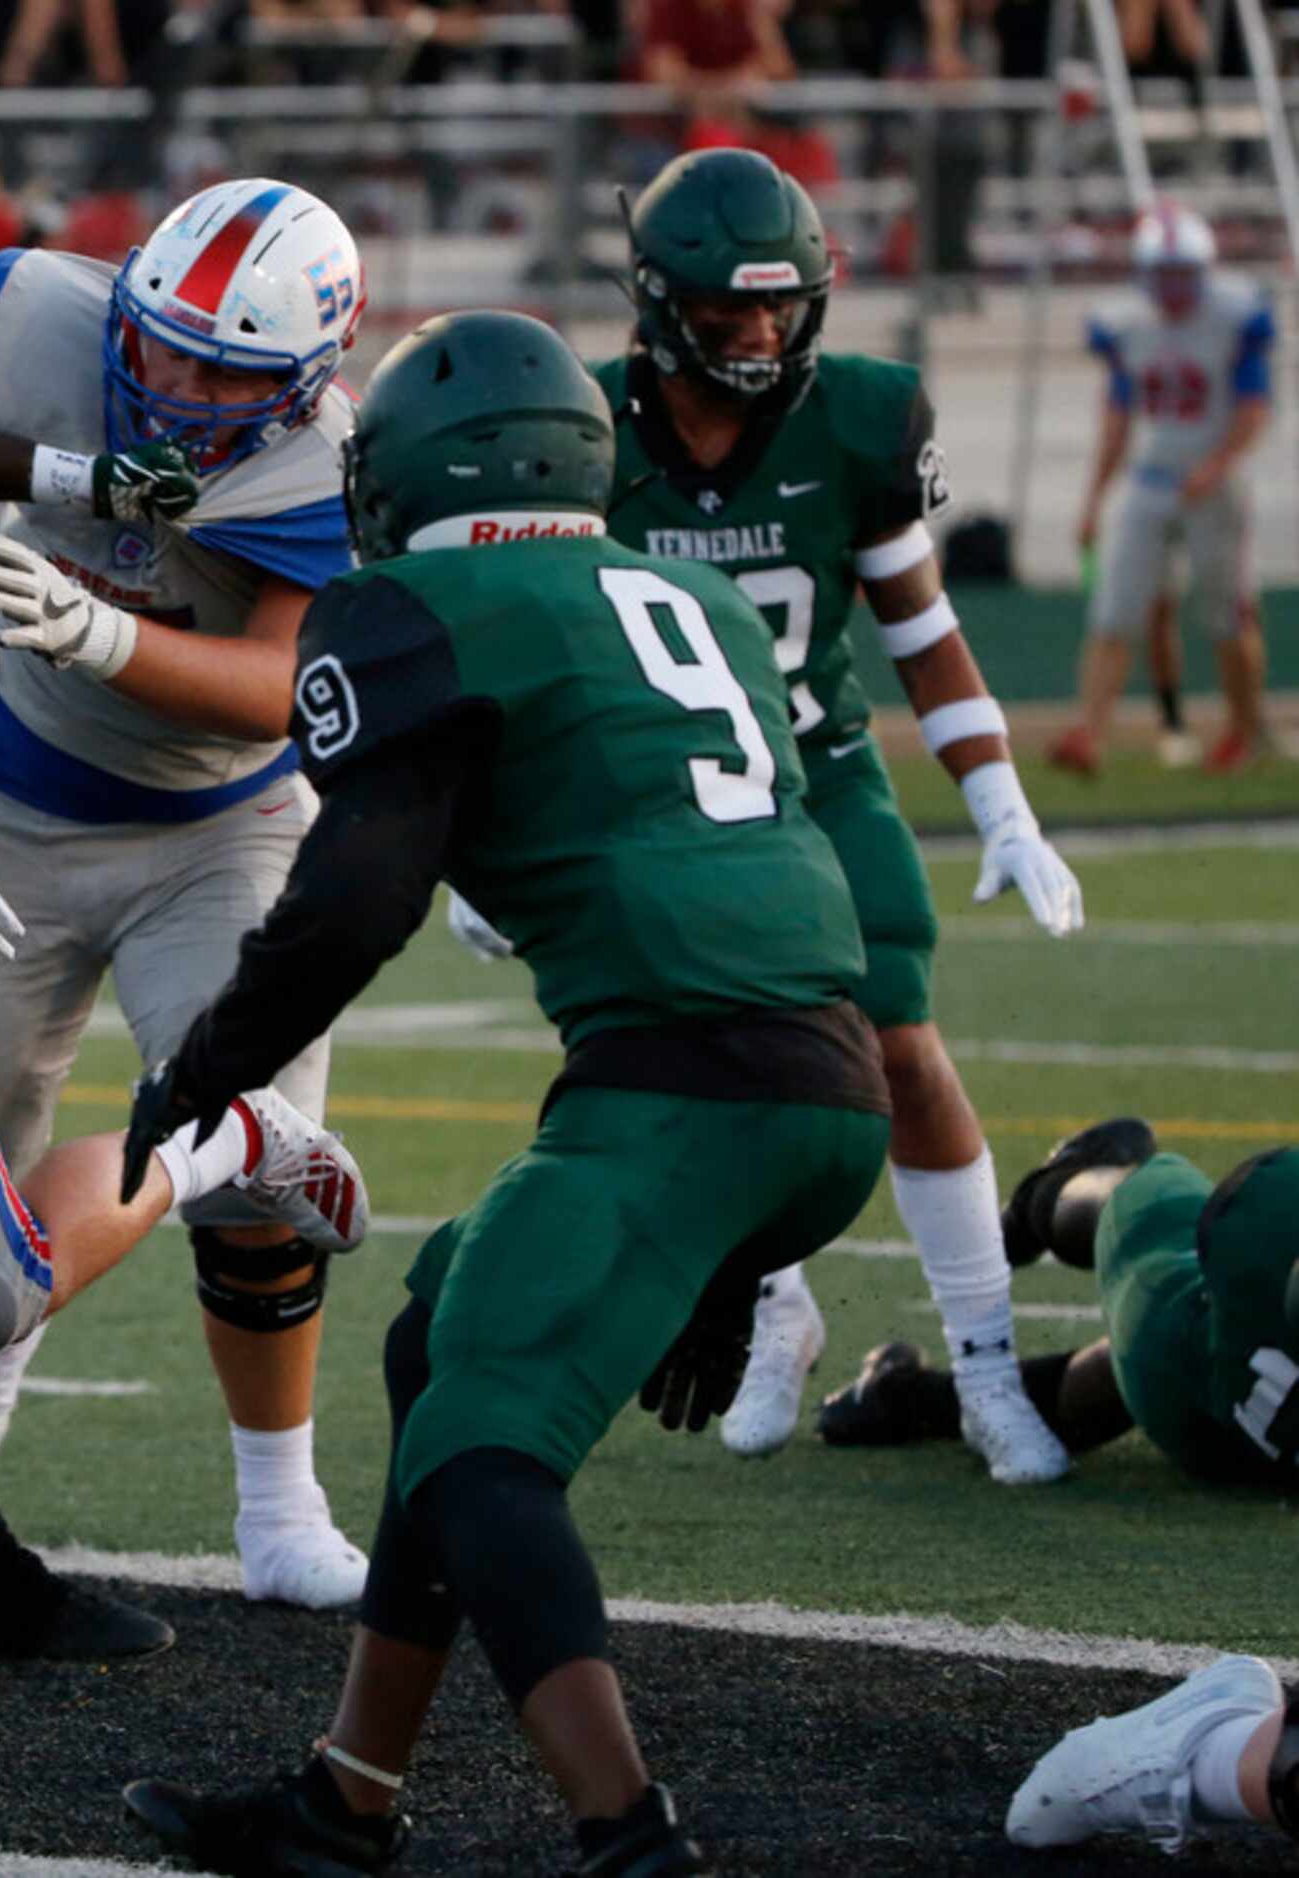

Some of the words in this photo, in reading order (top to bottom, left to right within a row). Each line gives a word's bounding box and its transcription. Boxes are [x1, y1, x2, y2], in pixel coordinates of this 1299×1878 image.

[645, 522, 786, 562] KENNEDALE
[297, 652, 360, 760] 9
[597, 566, 779, 825] 9
